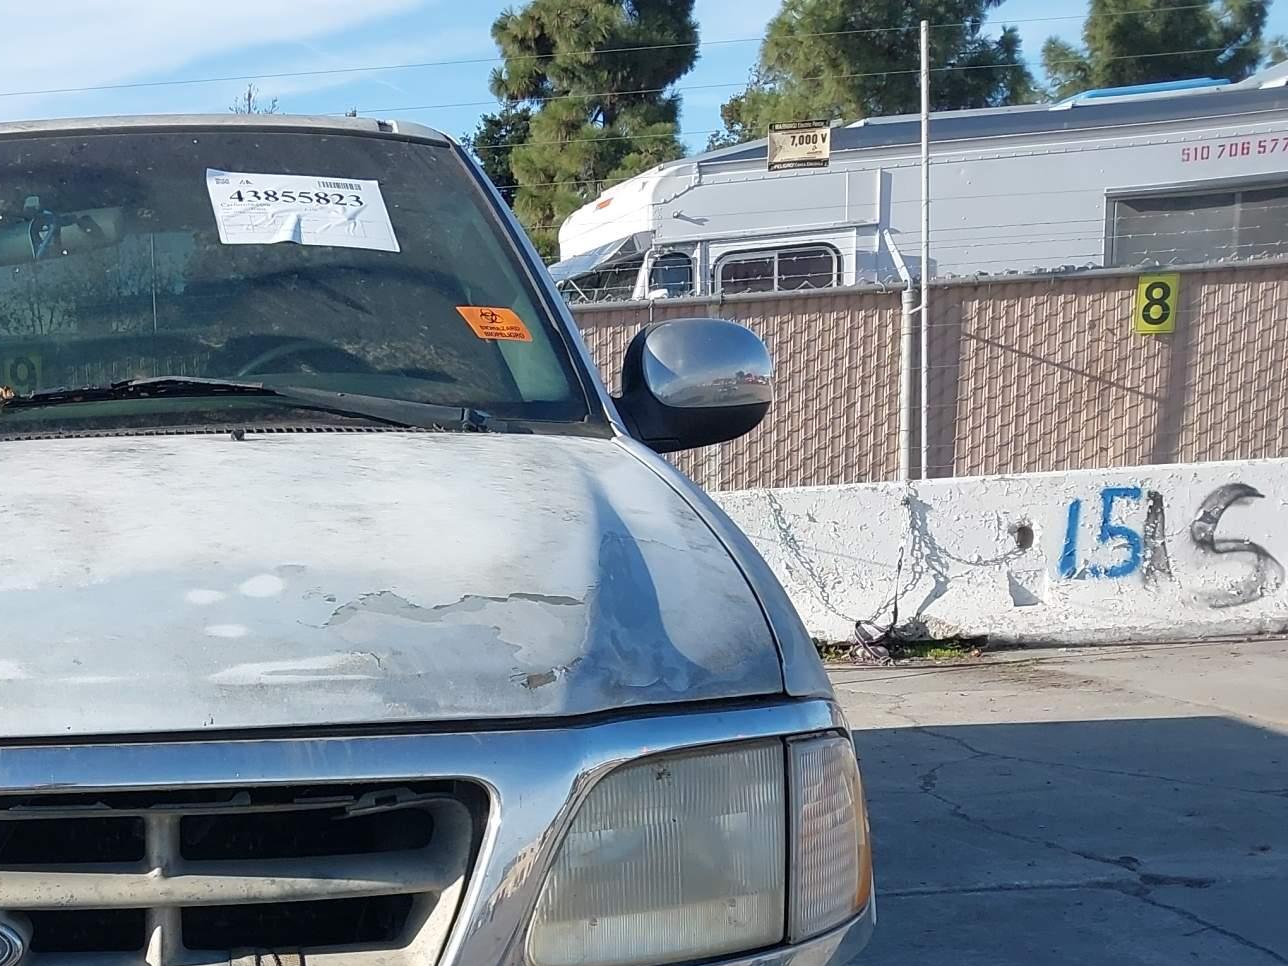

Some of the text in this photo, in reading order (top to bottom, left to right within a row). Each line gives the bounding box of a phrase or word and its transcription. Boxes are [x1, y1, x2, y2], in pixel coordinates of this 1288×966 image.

[790, 133, 828, 147] 7,000 V
[1181, 146, 1210, 162] 510
[1217, 142, 1250, 159] 706
[229, 189, 364, 207] 43855823
[1142, 281, 1170, 326] 8
